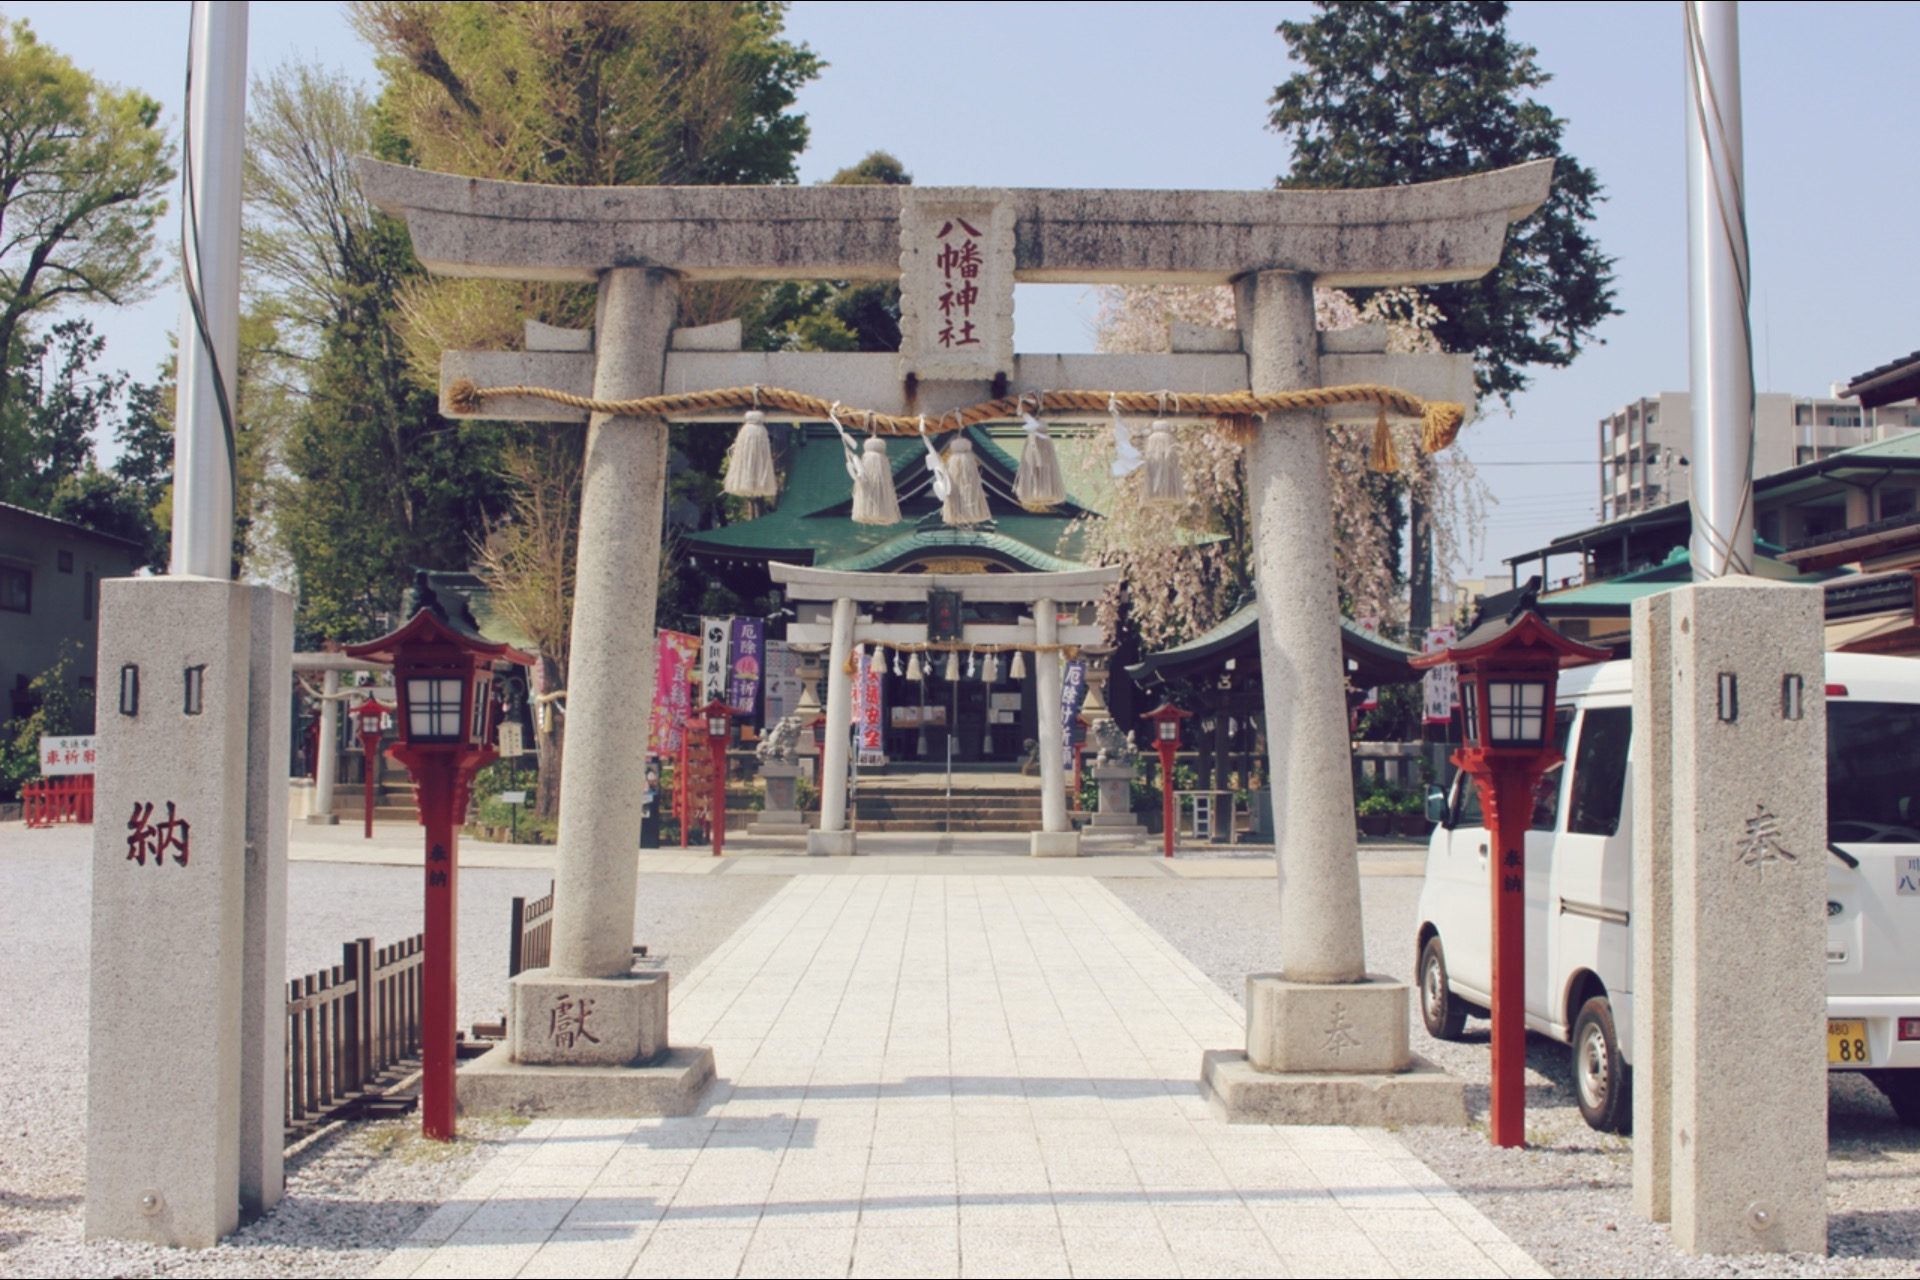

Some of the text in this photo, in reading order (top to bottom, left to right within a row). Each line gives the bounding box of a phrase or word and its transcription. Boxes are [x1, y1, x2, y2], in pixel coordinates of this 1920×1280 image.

[937, 217, 983, 348] 八幡神社
[741, 624, 757, 655] 厄除
[60, 739, 96, 748] 交通安
[126, 800, 190, 868] 納
[1735, 803, 1797, 883] 奉
[1899, 875, 1920, 891] 八
[1320, 1001, 1361, 1056] 奉
[1839, 1039, 1865, 1061] 88
